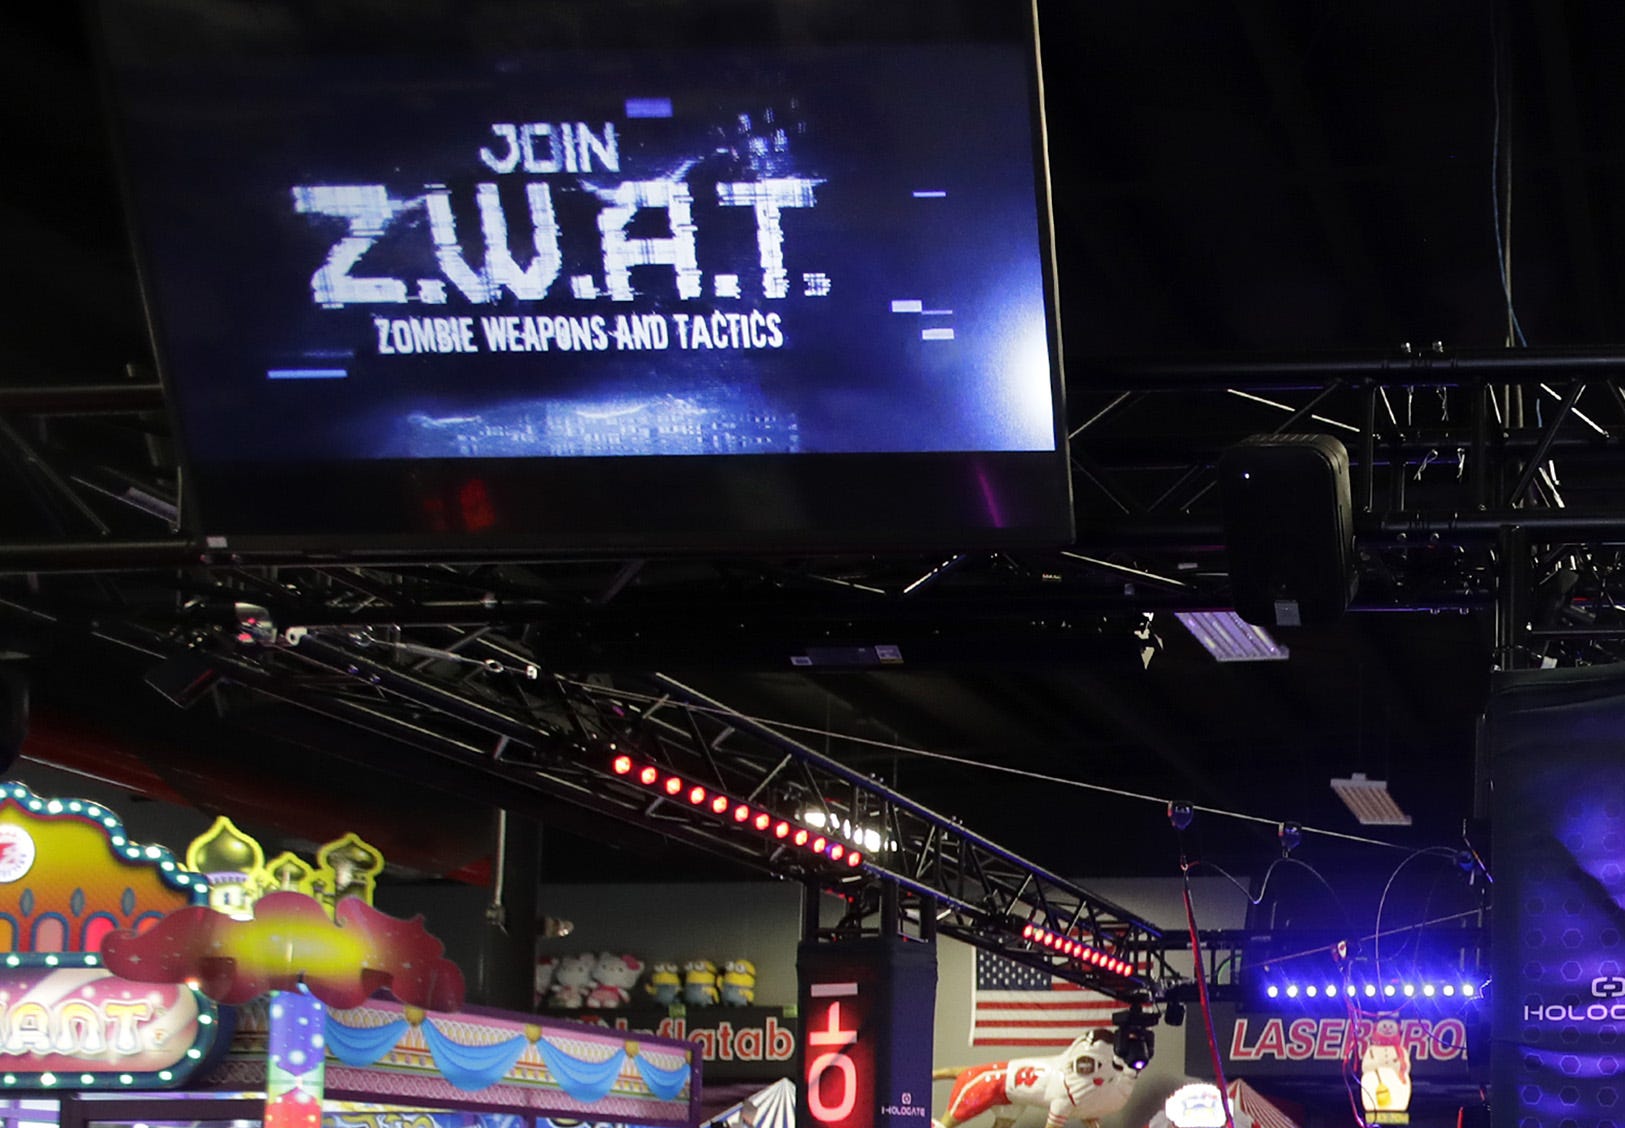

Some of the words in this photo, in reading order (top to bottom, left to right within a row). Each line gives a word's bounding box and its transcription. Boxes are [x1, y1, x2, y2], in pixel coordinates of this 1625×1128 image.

[480, 122, 620, 174] JOIN
[293, 179, 831, 307] Z.W.A.T.
[374, 316, 477, 354] ZOMBIE
[487, 315, 606, 353] WEAPONS
[616, 315, 668, 351] AND
[675, 309, 783, 351] TACTICS
[0, 1000, 151, 1055] ANT
[881, 1106, 926, 1117] HOLOGATE
